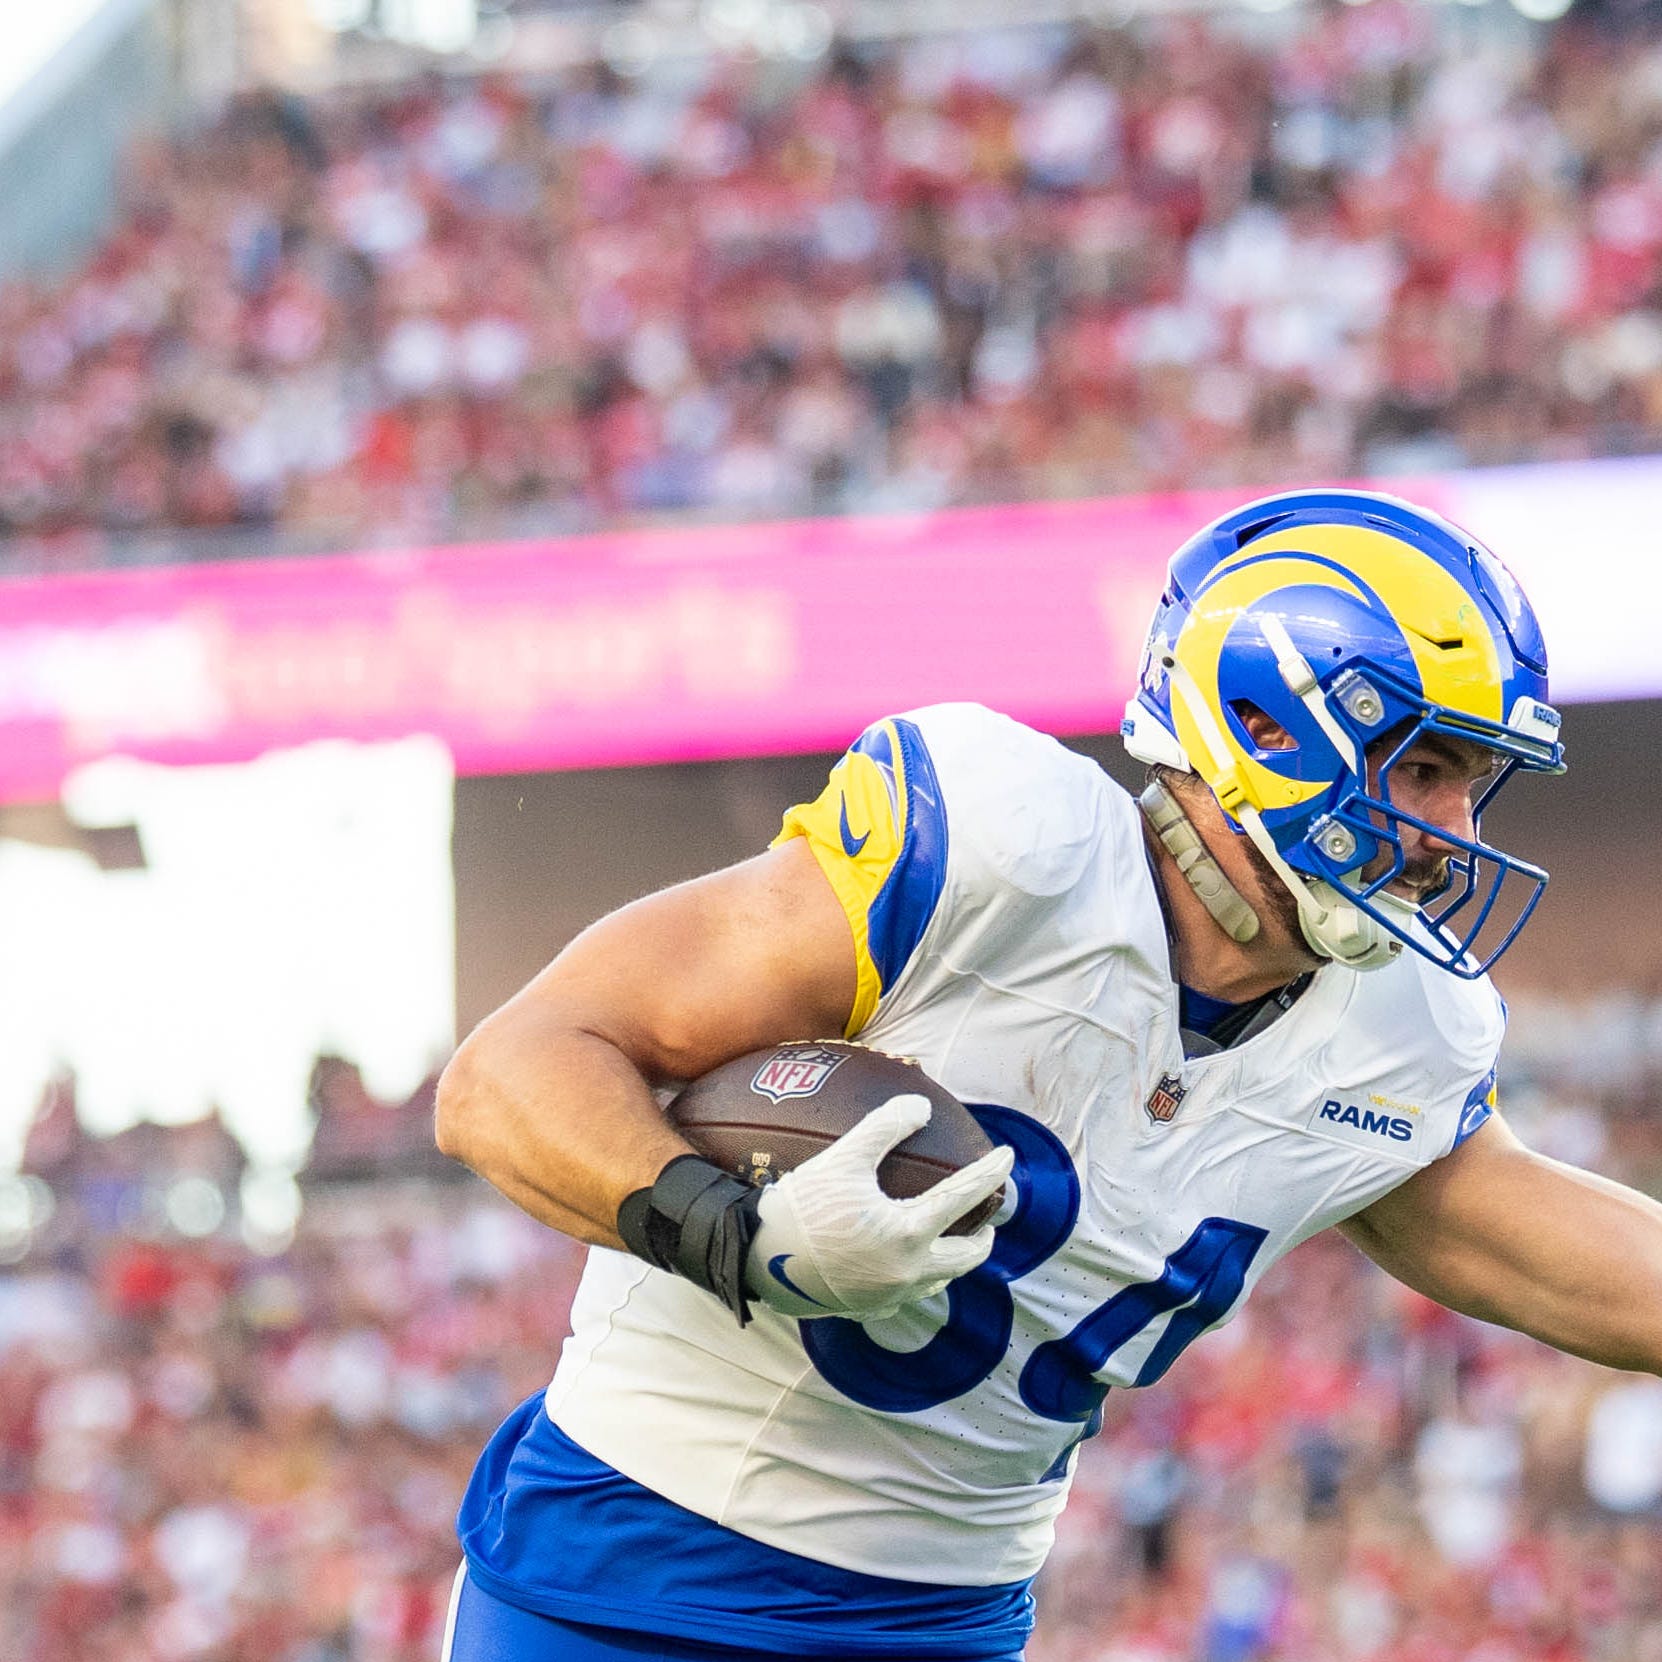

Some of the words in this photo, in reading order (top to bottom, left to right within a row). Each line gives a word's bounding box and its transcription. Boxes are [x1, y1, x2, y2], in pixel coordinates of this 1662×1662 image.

[759, 1060, 820, 1091] NFL
[1150, 1091, 1175, 1118] NFL
[1319, 1099, 1414, 1142] RAMS
[799, 1103, 1270, 1484] 84
